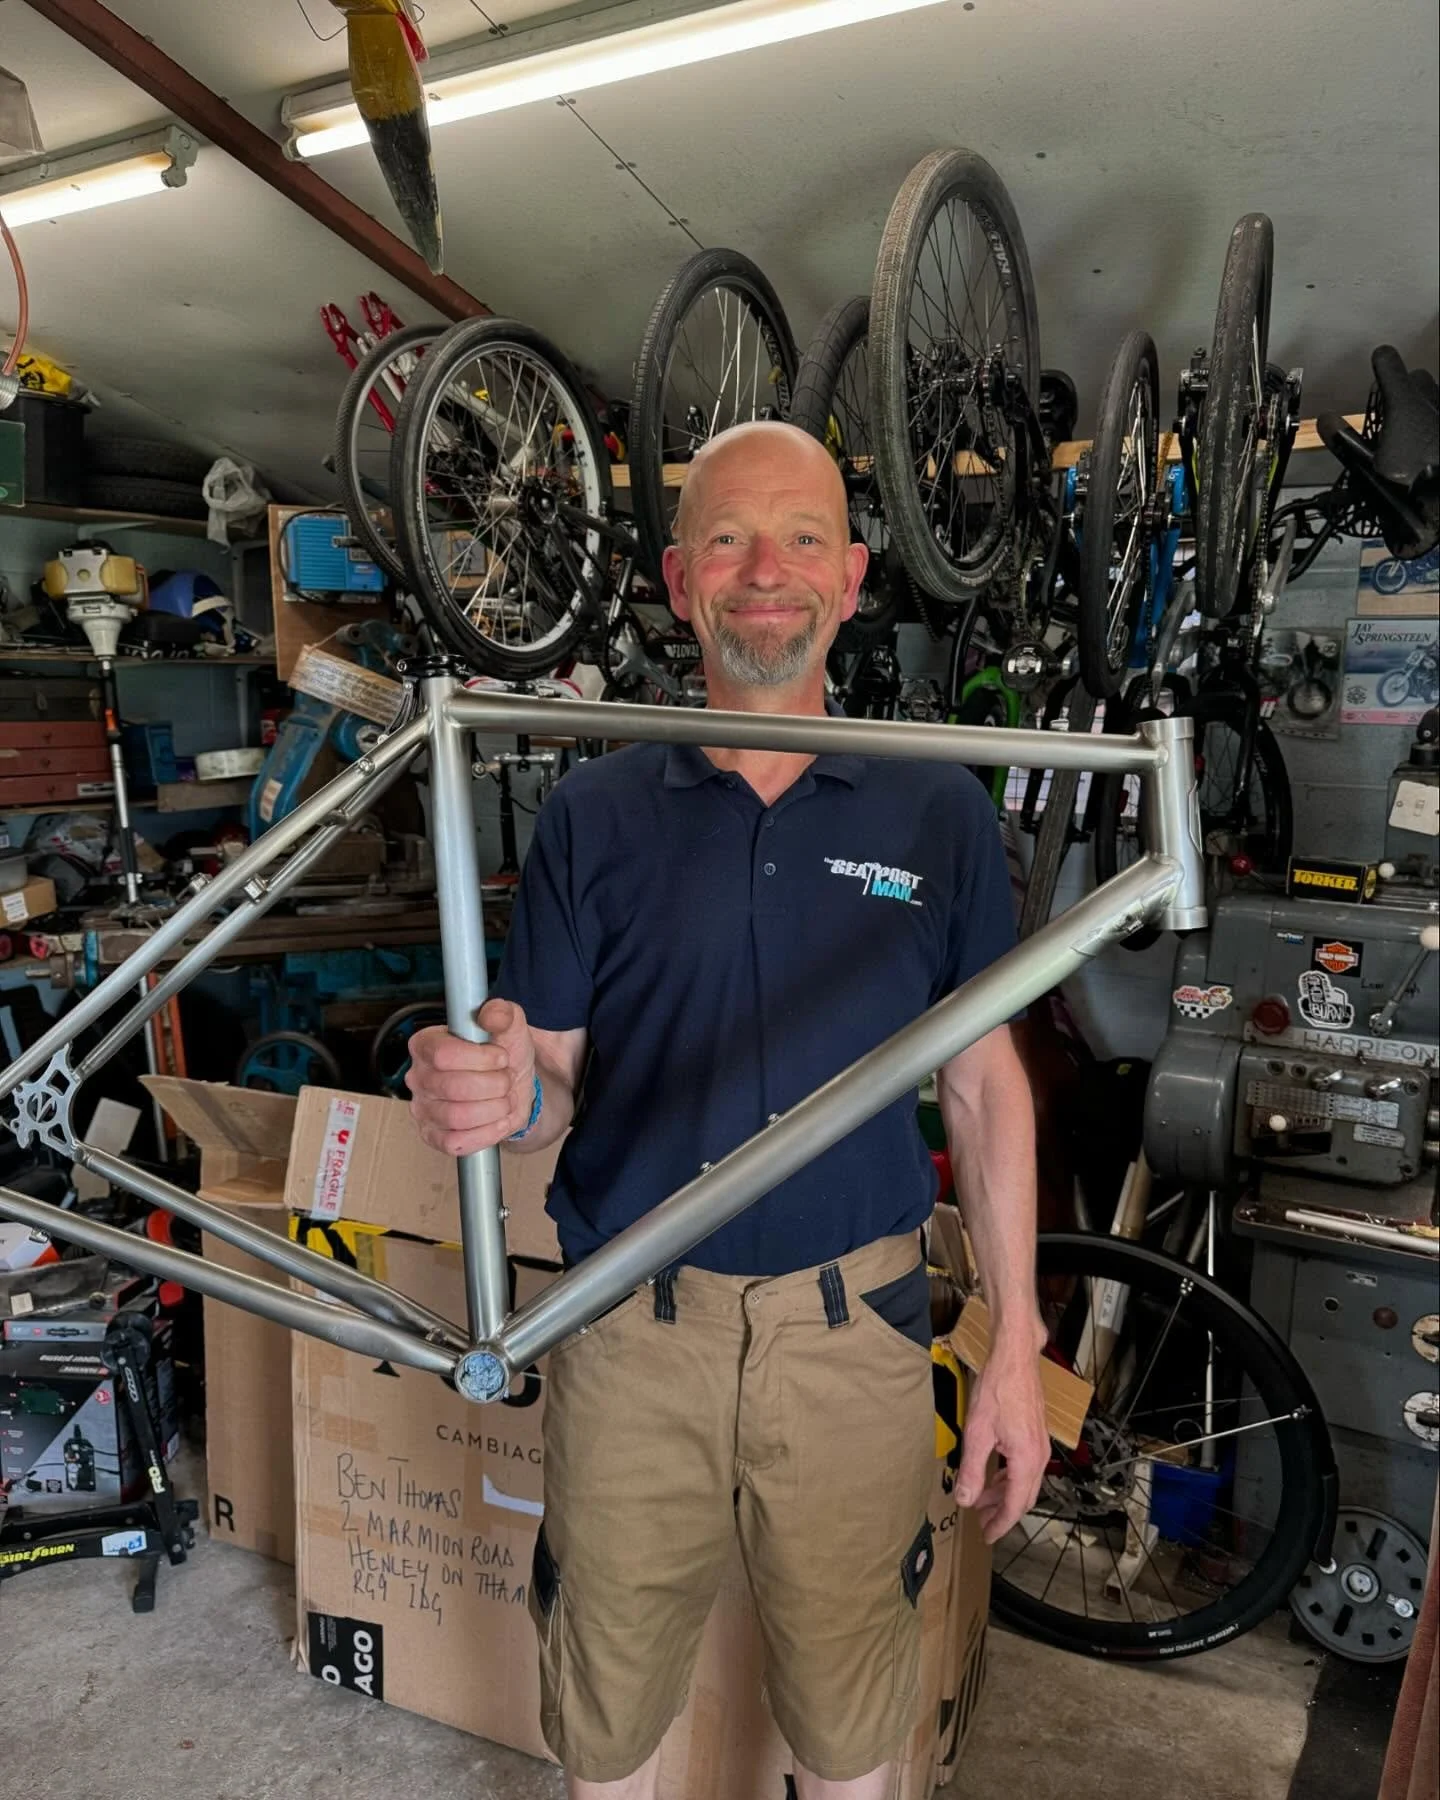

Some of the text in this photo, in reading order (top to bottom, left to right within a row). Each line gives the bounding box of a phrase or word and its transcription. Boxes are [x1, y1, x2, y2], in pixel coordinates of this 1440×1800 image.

[1352, 623, 1374, 639] JAY
[1354, 632, 1431, 646] SPRINGSTEEN
[872, 880, 912, 902] MAN
[1304, 1031, 1439, 1065] HARRISON
[325, 1149, 346, 1211] FRAGILE
[337, 1453, 386, 1500] BEN
[367, 1510, 463, 1564] MARMION
[471, 1535, 514, 1569] ROAD
[348, 1534, 429, 1593] HENLEY
[441, 1563, 464, 1588] ON
